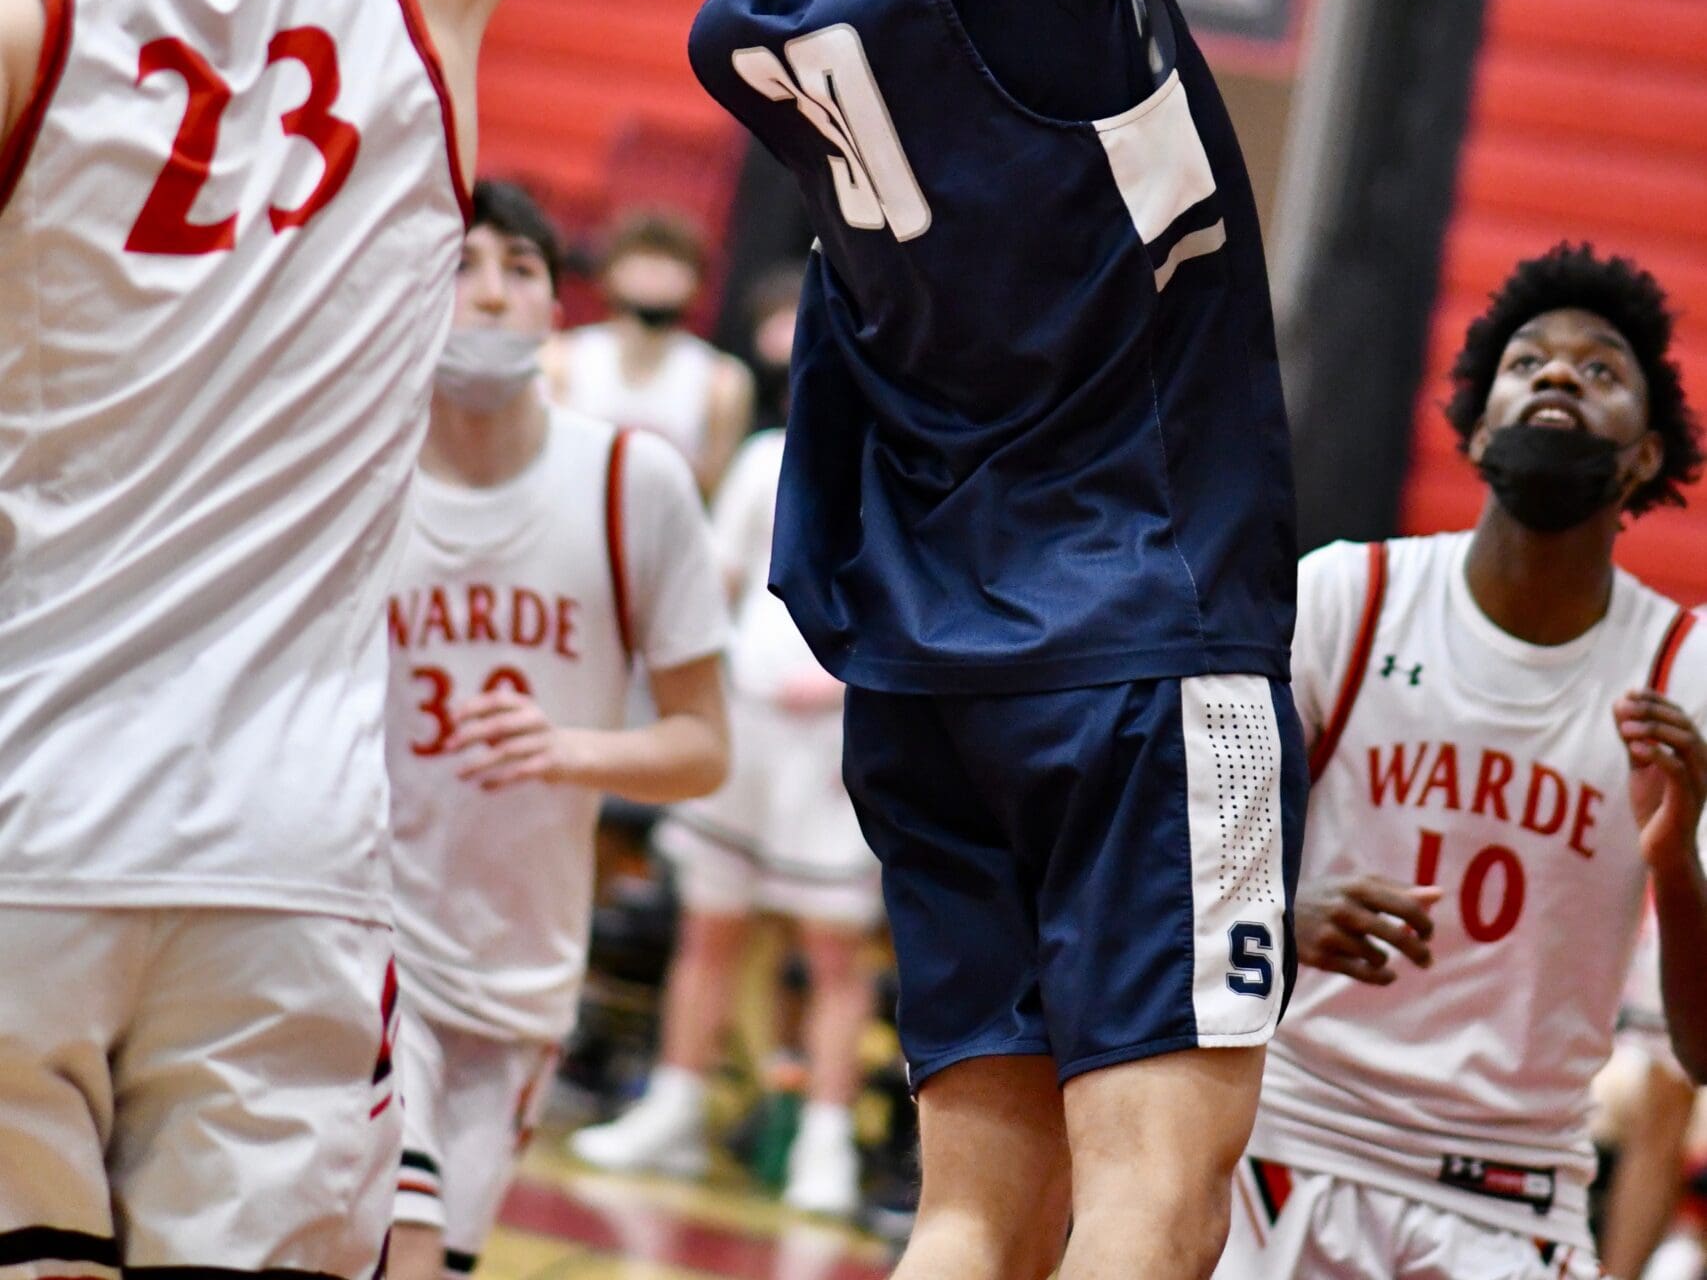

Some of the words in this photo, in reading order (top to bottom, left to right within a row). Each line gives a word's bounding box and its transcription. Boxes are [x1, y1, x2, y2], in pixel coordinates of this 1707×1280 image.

[123, 25, 361, 257] 23
[1366, 740, 1605, 859] WARDE
[1414, 828, 1526, 943] 10
[1226, 920, 1274, 1000] S
